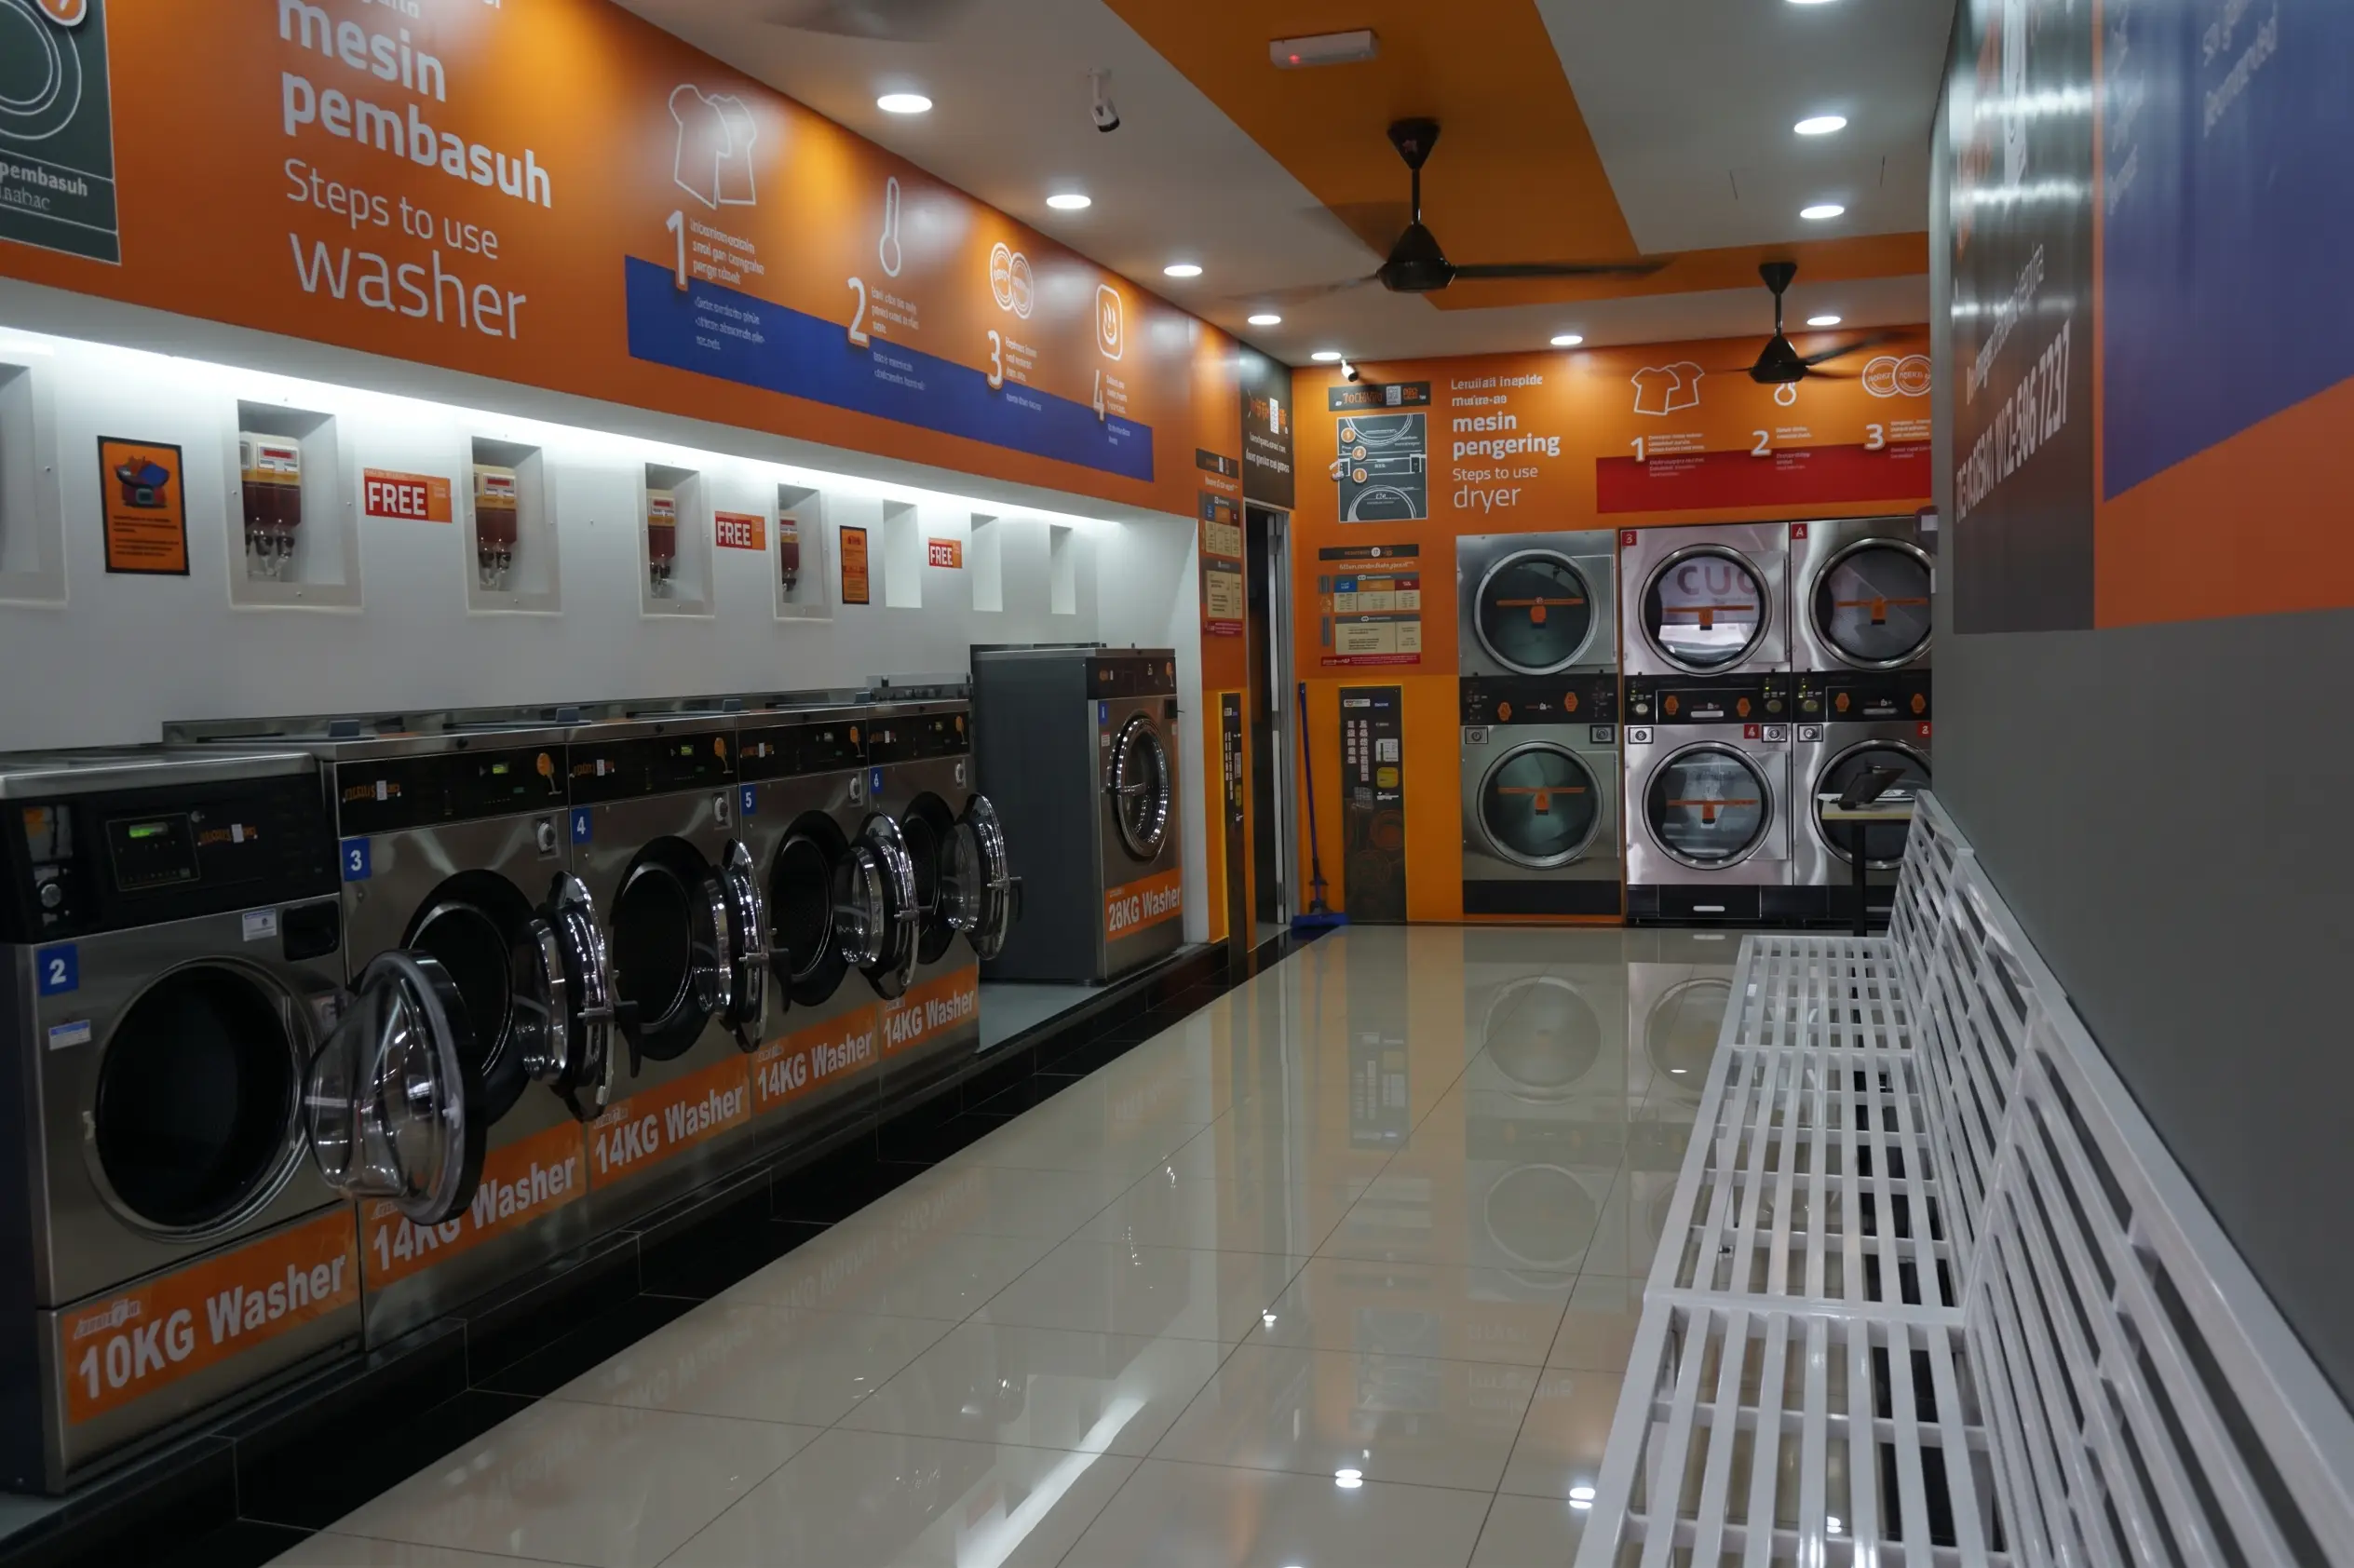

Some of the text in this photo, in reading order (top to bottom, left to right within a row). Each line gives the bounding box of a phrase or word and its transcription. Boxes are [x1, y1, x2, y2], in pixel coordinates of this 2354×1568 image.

[279, 0, 445, 102] mesin
[282, 71, 551, 208] pembasuh
[0, 161, 88, 196] pembasuh
[284, 158, 498, 260] Steps to use
[666, 210, 686, 285] 1
[847, 277, 868, 343] 2
[988, 330, 1002, 385] 3
[1093, 369, 1104, 421] 4
[1453, 411, 1517, 432] mesin
[1865, 424, 1883, 449] 3
[1453, 433, 1561, 461] pengering
[1630, 437, 1644, 462] 1
[1752, 430, 1771, 455] 2
[1453, 467, 1538, 483] Steps to use
[368, 481, 426, 516] FREE
[1454, 485, 1522, 513] dryer
[717, 521, 751, 547] FREE
[930, 546, 954, 566] FREE
[576, 817, 586, 835] 4
[350, 850, 362, 872] 3
[1109, 885, 1181, 932] 28KG Washer
[49, 958, 67, 985] 2
[884, 990, 975, 1048] 14KG Washer
[758, 1030, 873, 1102] 14KG Washer
[595, 1084, 743, 1174] 14KG Washer
[472, 1156, 575, 1230] Washer
[79, 1309, 196, 1399] 10KG
[207, 1252, 347, 1345] Washer
